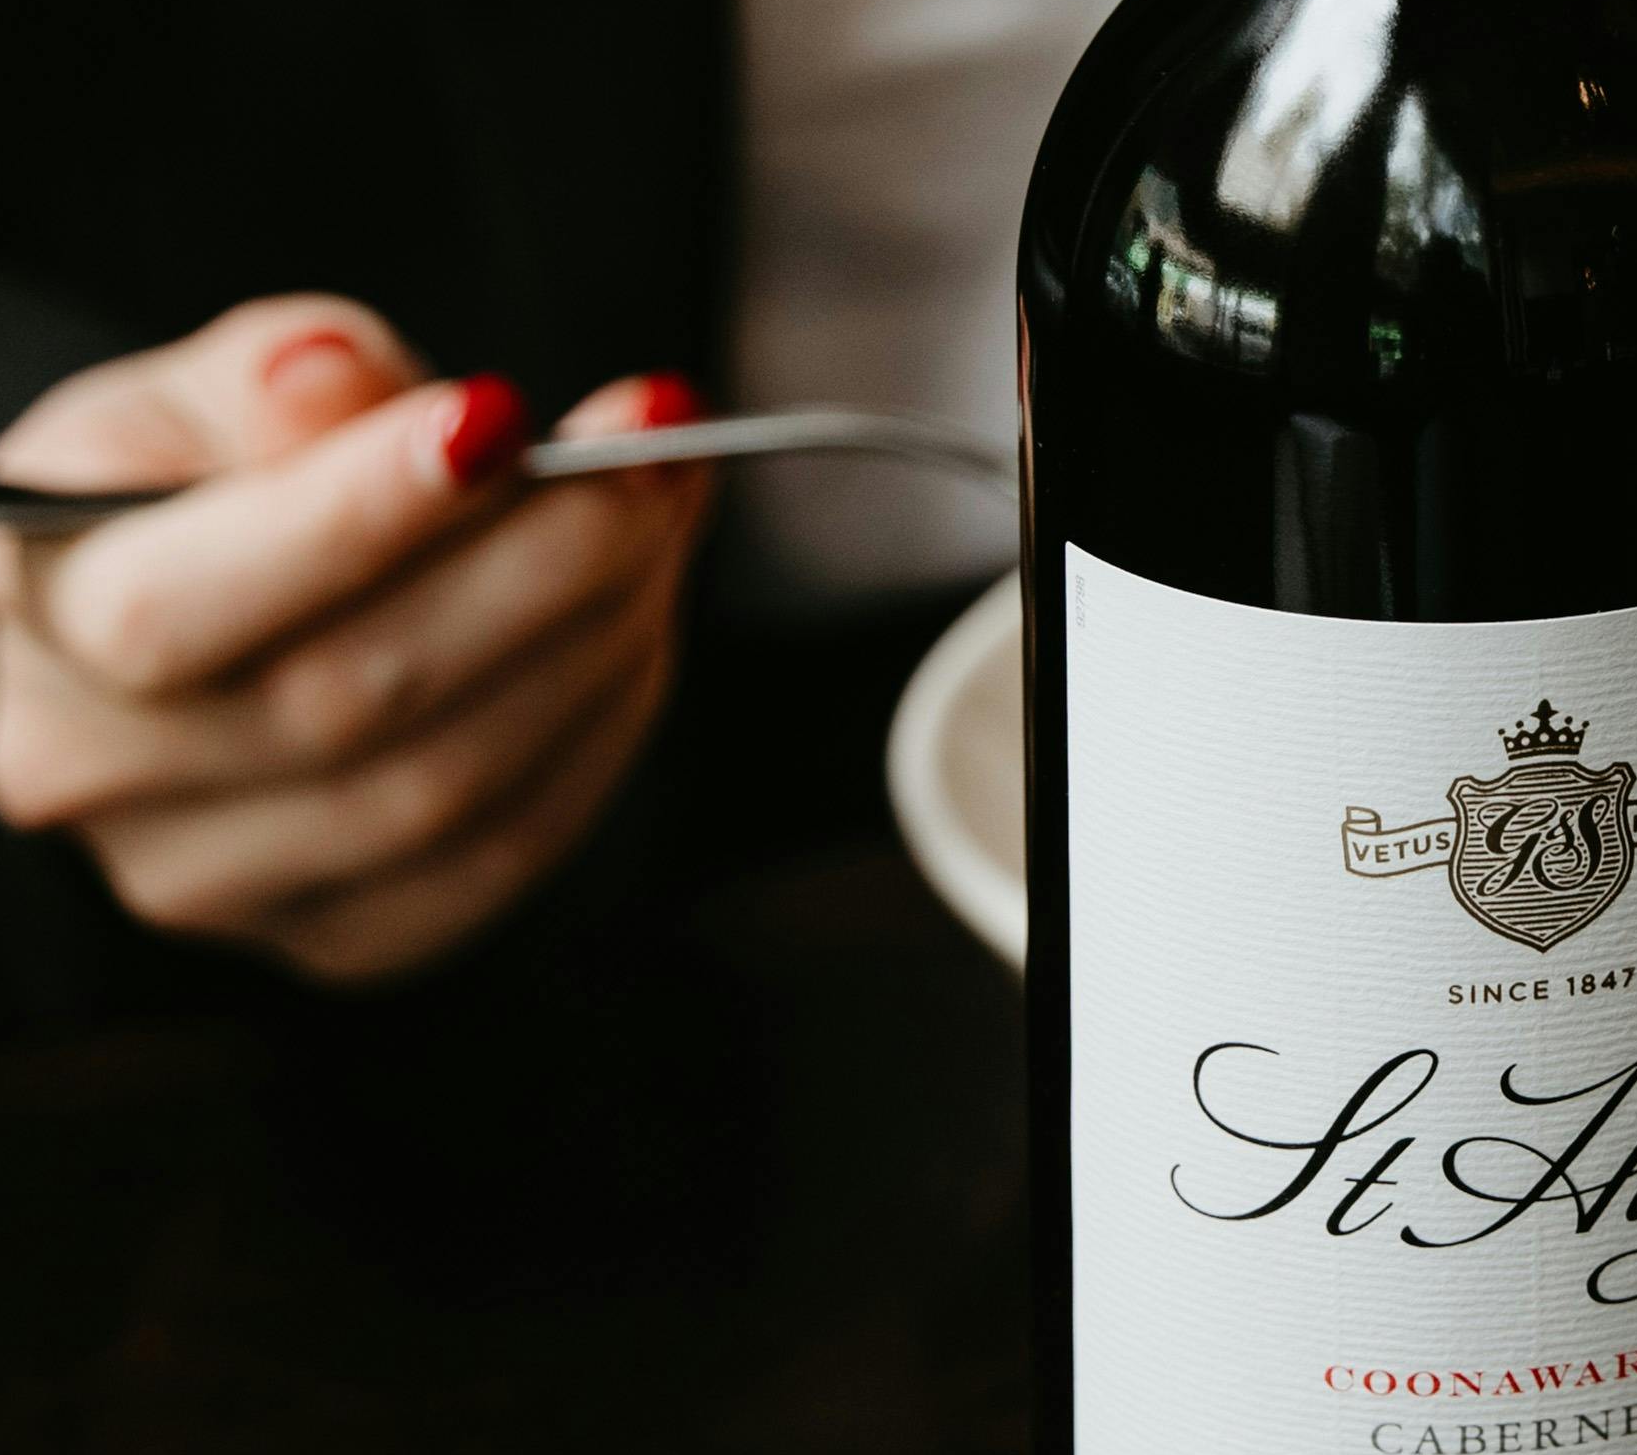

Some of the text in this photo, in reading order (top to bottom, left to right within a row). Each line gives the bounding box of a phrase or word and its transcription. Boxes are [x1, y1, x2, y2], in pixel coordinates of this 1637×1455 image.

[1352, 831, 1450, 864] VETUS
[1449, 966, 1637, 1005] SINCE 1847
[1171, 1042, 1439, 1236] St
